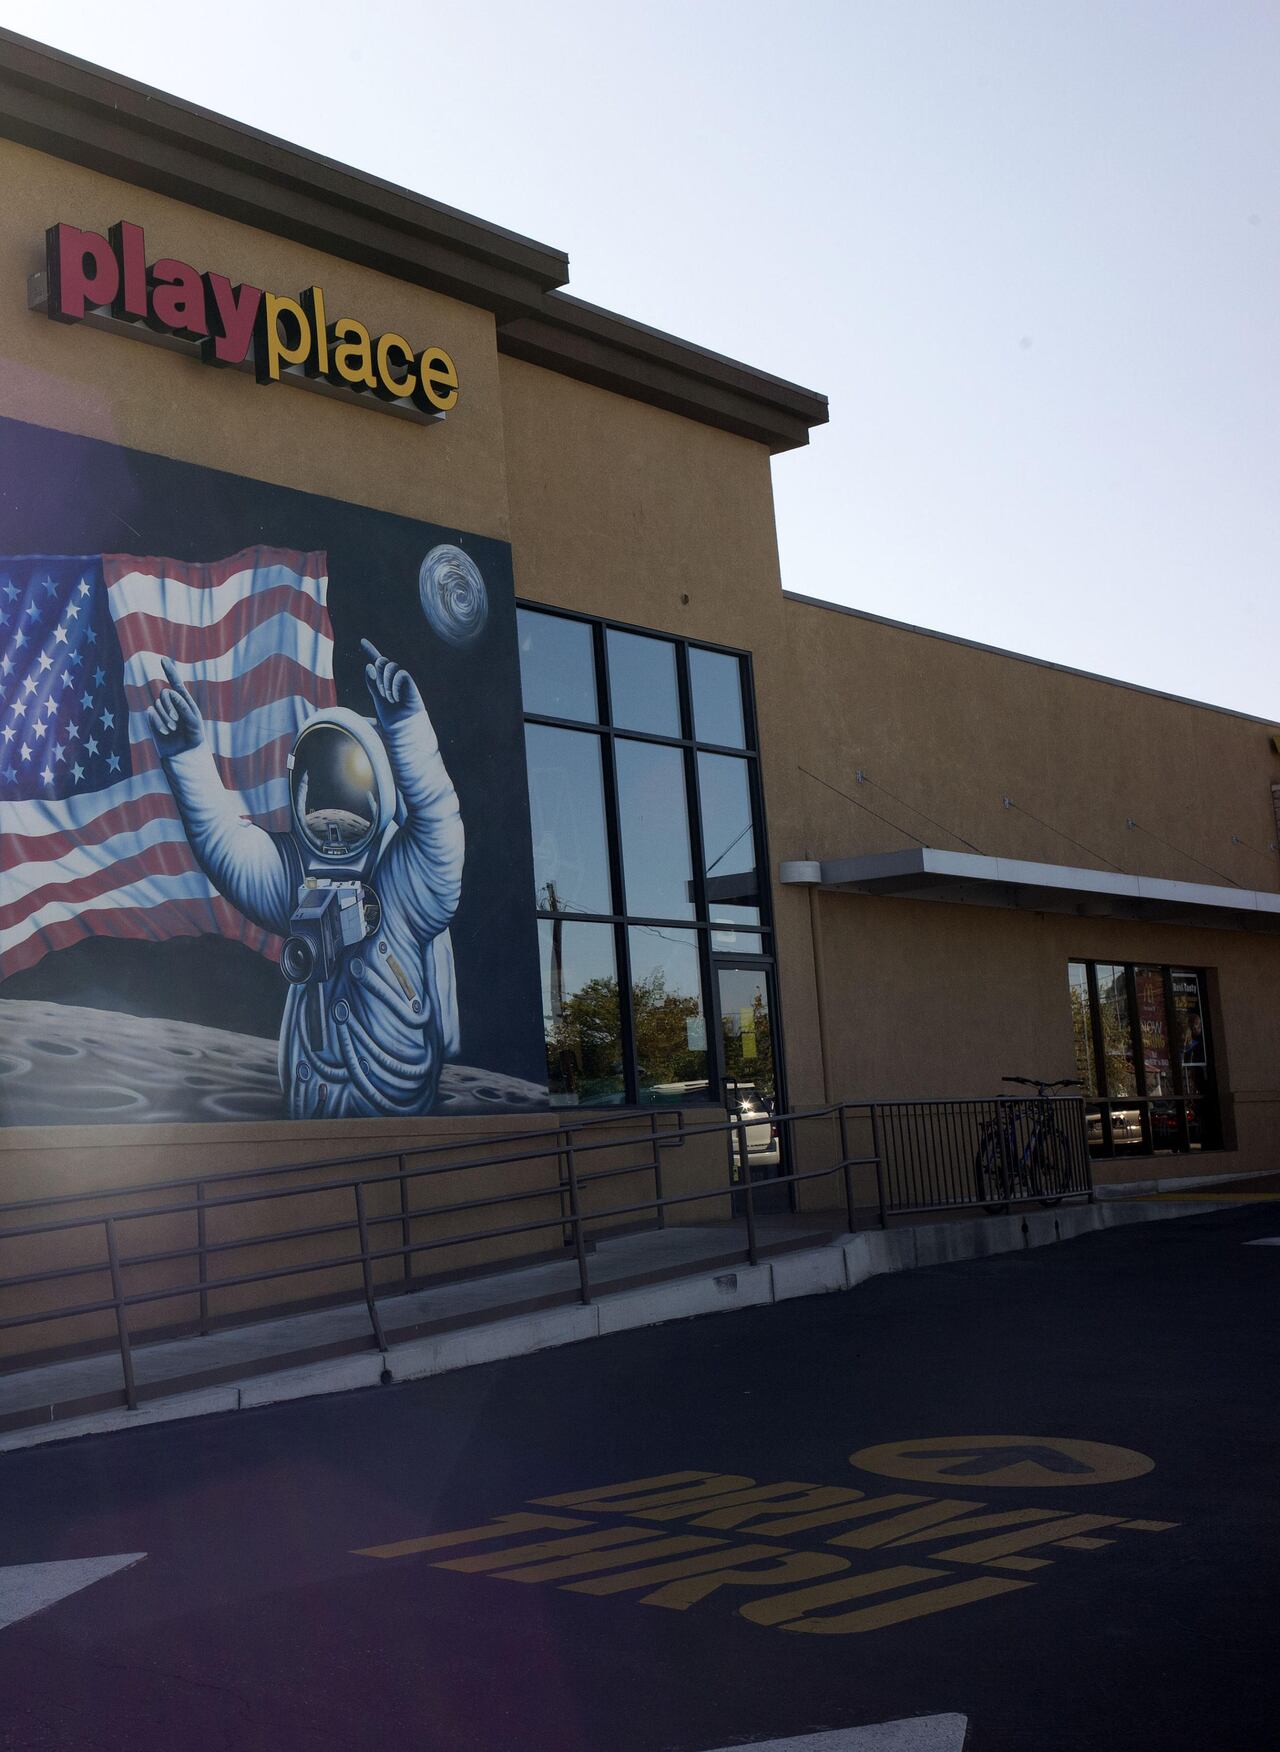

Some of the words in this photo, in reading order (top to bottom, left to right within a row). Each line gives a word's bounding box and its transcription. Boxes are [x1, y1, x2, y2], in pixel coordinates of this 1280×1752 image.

[48, 220, 459, 411] playplace
[348, 1511, 1038, 1634] THRU
[524, 1470, 1182, 1572] DRIVE
